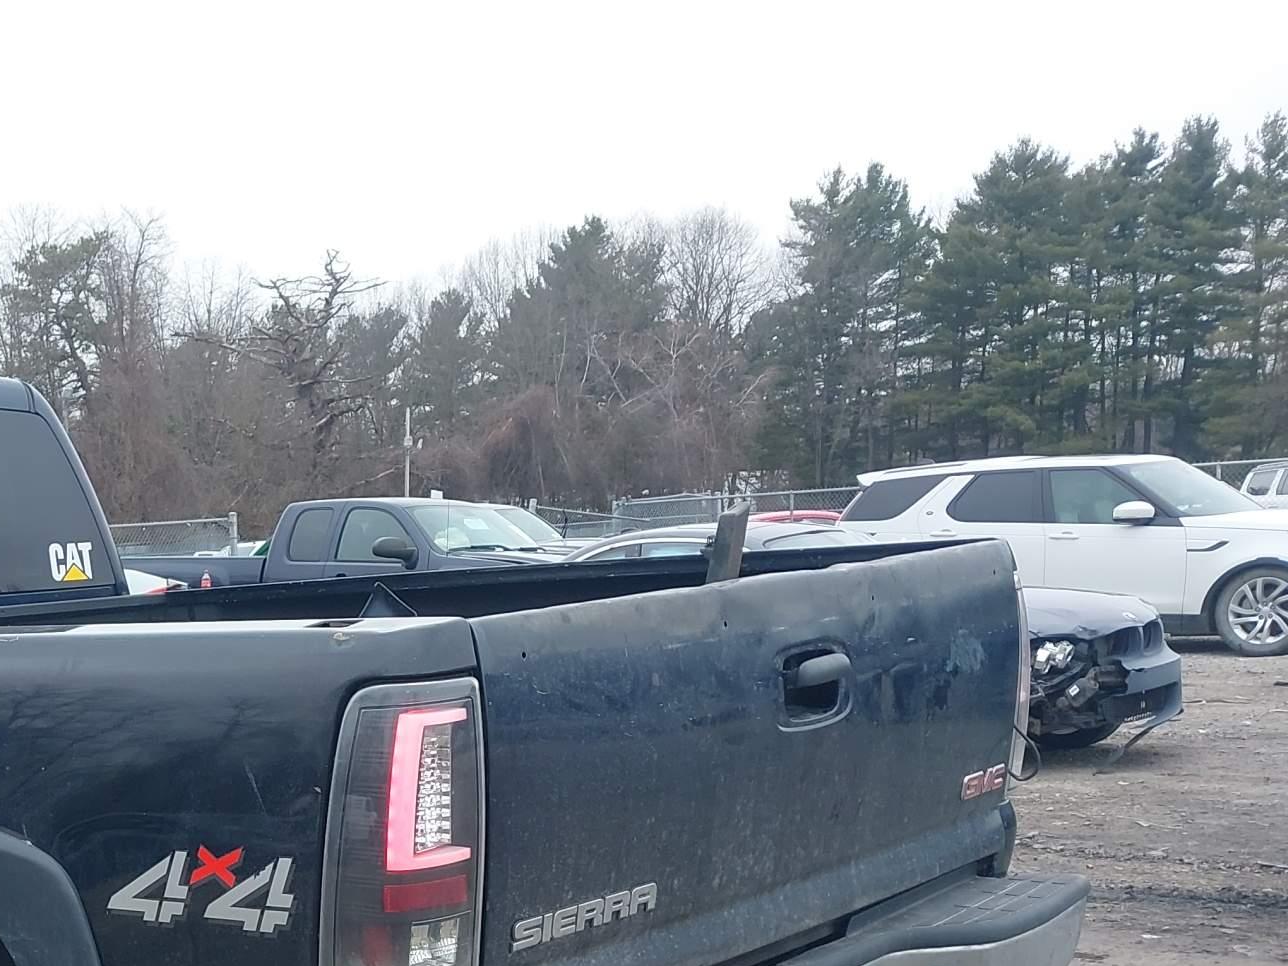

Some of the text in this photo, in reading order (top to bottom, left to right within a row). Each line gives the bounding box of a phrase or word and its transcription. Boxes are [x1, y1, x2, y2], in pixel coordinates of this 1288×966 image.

[48, 541, 93, 582] CAT
[961, 763, 1006, 801] GMC
[511, 881, 658, 952] SIERRA
